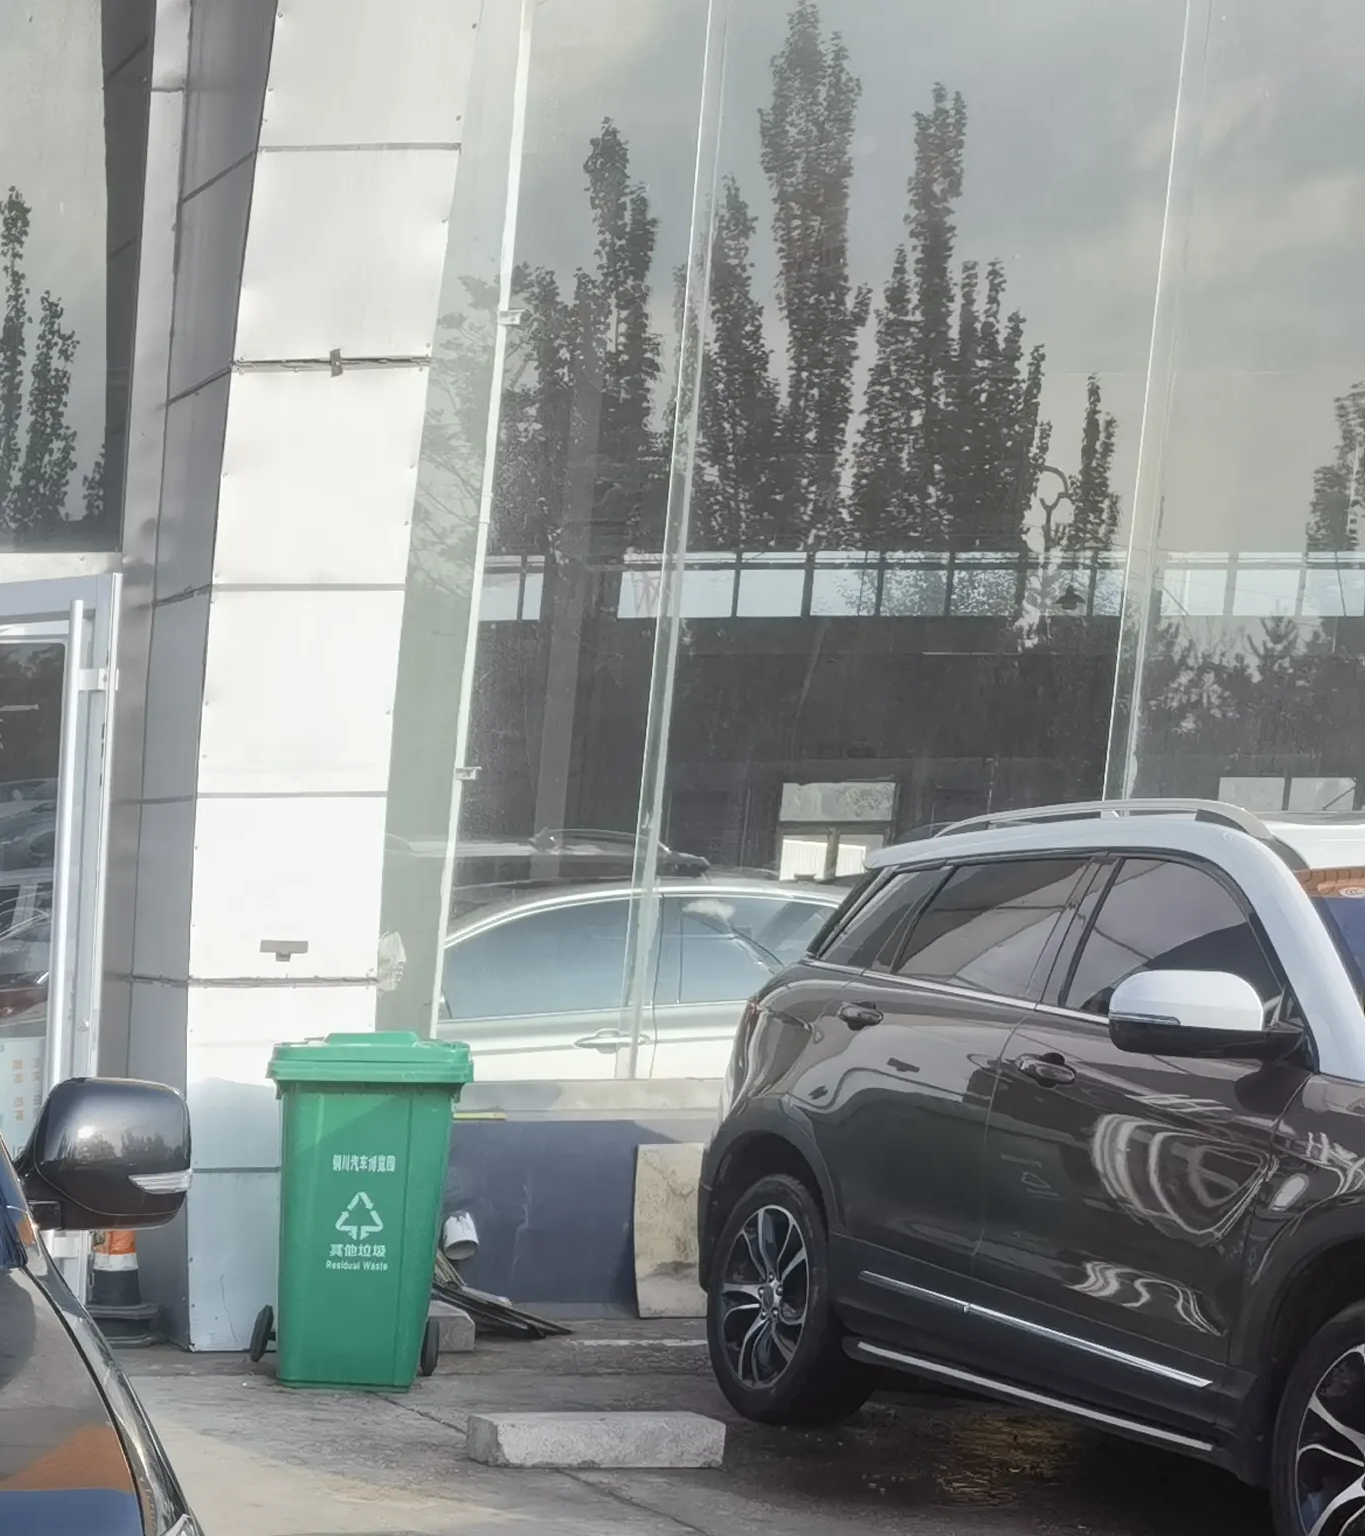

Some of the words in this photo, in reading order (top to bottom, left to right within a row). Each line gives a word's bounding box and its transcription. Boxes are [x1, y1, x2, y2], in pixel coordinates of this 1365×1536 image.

[329, 1243, 386, 1258] 其他垃圾
[325, 1259, 361, 1271] Residual
[363, 1260, 389, 1271] Waste
